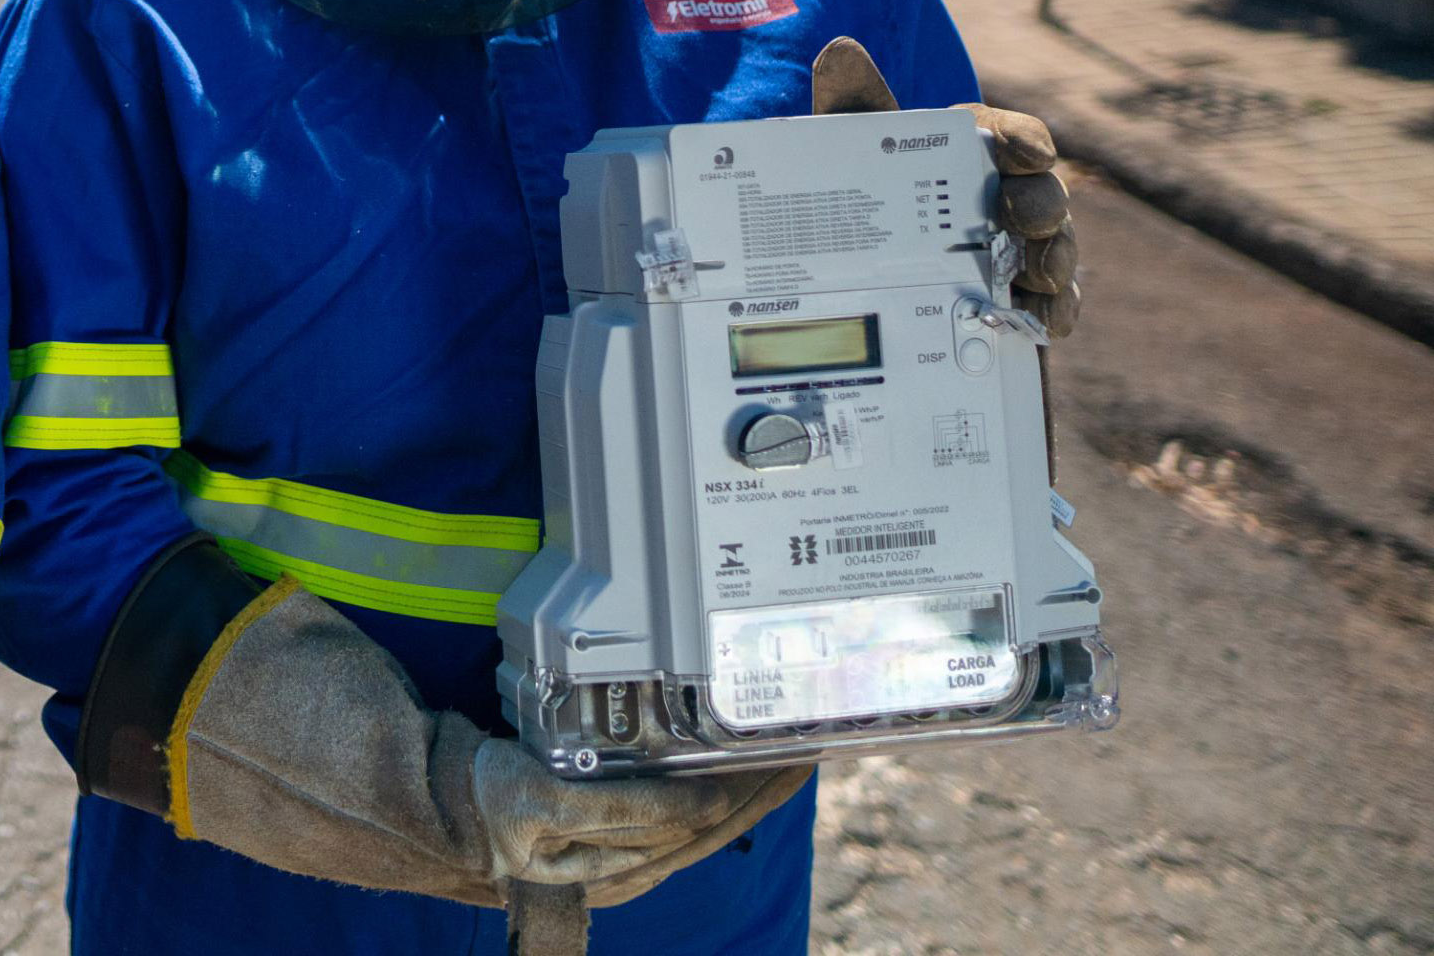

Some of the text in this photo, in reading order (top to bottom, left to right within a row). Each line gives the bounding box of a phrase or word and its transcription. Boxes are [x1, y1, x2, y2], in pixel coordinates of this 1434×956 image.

[898, 135, 949, 149] nansen
[747, 300, 799, 314] nansen
[916, 306, 943, 317] DEM
[918, 352, 947, 364] DISP
[767, 396, 781, 405] Wh
[789, 394, 806, 403] REV
[833, 390, 860, 401] Ligado
[705, 481, 732, 493] NSX
[706, 495, 730, 505] 120V
[735, 491, 777, 504] 30(200)A
[811, 487, 836, 497] 4Fios
[841, 484, 860, 494] 3EL
[835, 520, 925, 536] MEDIDOR INTELIGENTE
[844, 549, 921, 566] 0044570267
[886, 566, 934, 579] BRASILEIRA
[947, 654, 995, 672] CARGA
[733, 668, 783, 685] LINHA
[948, 672, 985, 689] LOAD
[734, 685, 783, 703] LINEA
[736, 703, 774, 719] LINE
